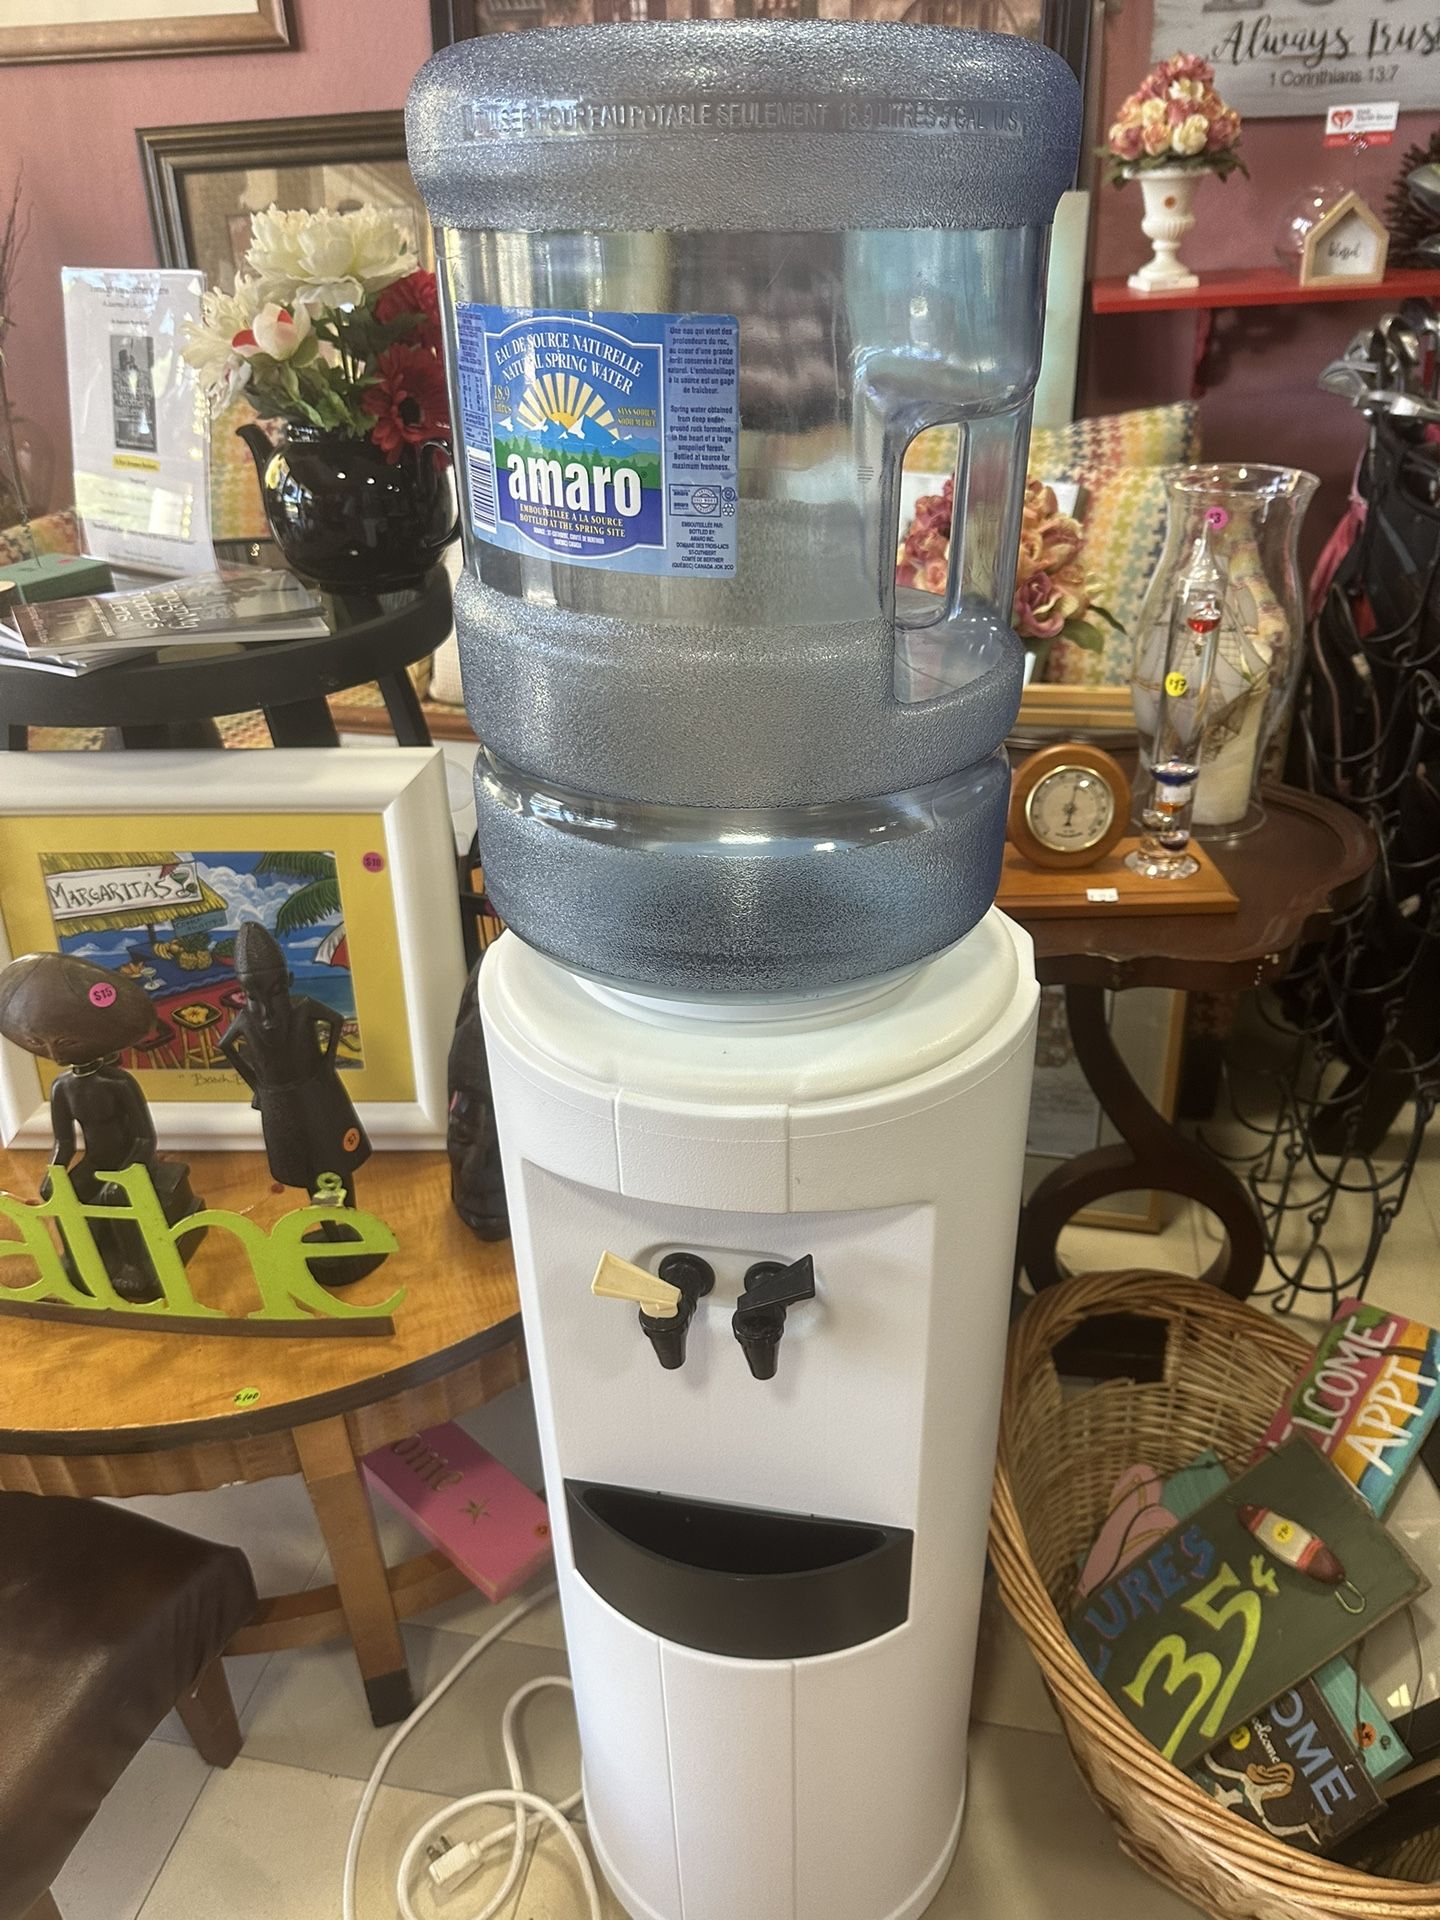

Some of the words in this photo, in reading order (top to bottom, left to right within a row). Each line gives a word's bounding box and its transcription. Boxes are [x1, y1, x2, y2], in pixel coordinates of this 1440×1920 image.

[1213, 14, 1353, 67] Always
[1281, 67, 1362, 86] Corinthians
[590, 103, 625, 129] EAU
[630, 103, 713, 128] POTABLE
[716, 102, 829, 128] SEULEMENT
[494, 344, 512, 366] EAU
[512, 336, 526, 353] DE
[526, 332, 570, 351] SOURCE
[572, 334, 644, 378] NATURELLE
[545, 352, 587, 373] SPRING
[591, 359, 634, 395] WATER
[493, 384, 511, 401] 18.9
[671, 405, 689, 414] Spring
[690, 406, 706, 414] water
[707, 406, 733, 414] obtained
[677, 415, 690, 423] from
[692, 415, 706, 424] deep
[670, 425, 689, 433] ground
[689, 434, 704, 442] heart
[717, 435, 732, 444] large
[672, 462, 700, 470] maximum
[673, 452, 693, 460] Bottled
[721, 454, 731, 462] for
[506, 453, 642, 518] amaro
[519, 513, 549, 527] BOTTLED
[549, 519, 558, 528] AT
[559, 521, 573, 531] THE
[575, 523, 605, 535] SPRING
[607, 528, 626, 538] SITE
[579, 513, 589, 523] LA
[591, 515, 623, 527] SOURCE
[93, 986, 113, 1001] $15
[1266, 1316, 1398, 1453] LCOME
[1345, 1355, 1437, 1476] APPT
